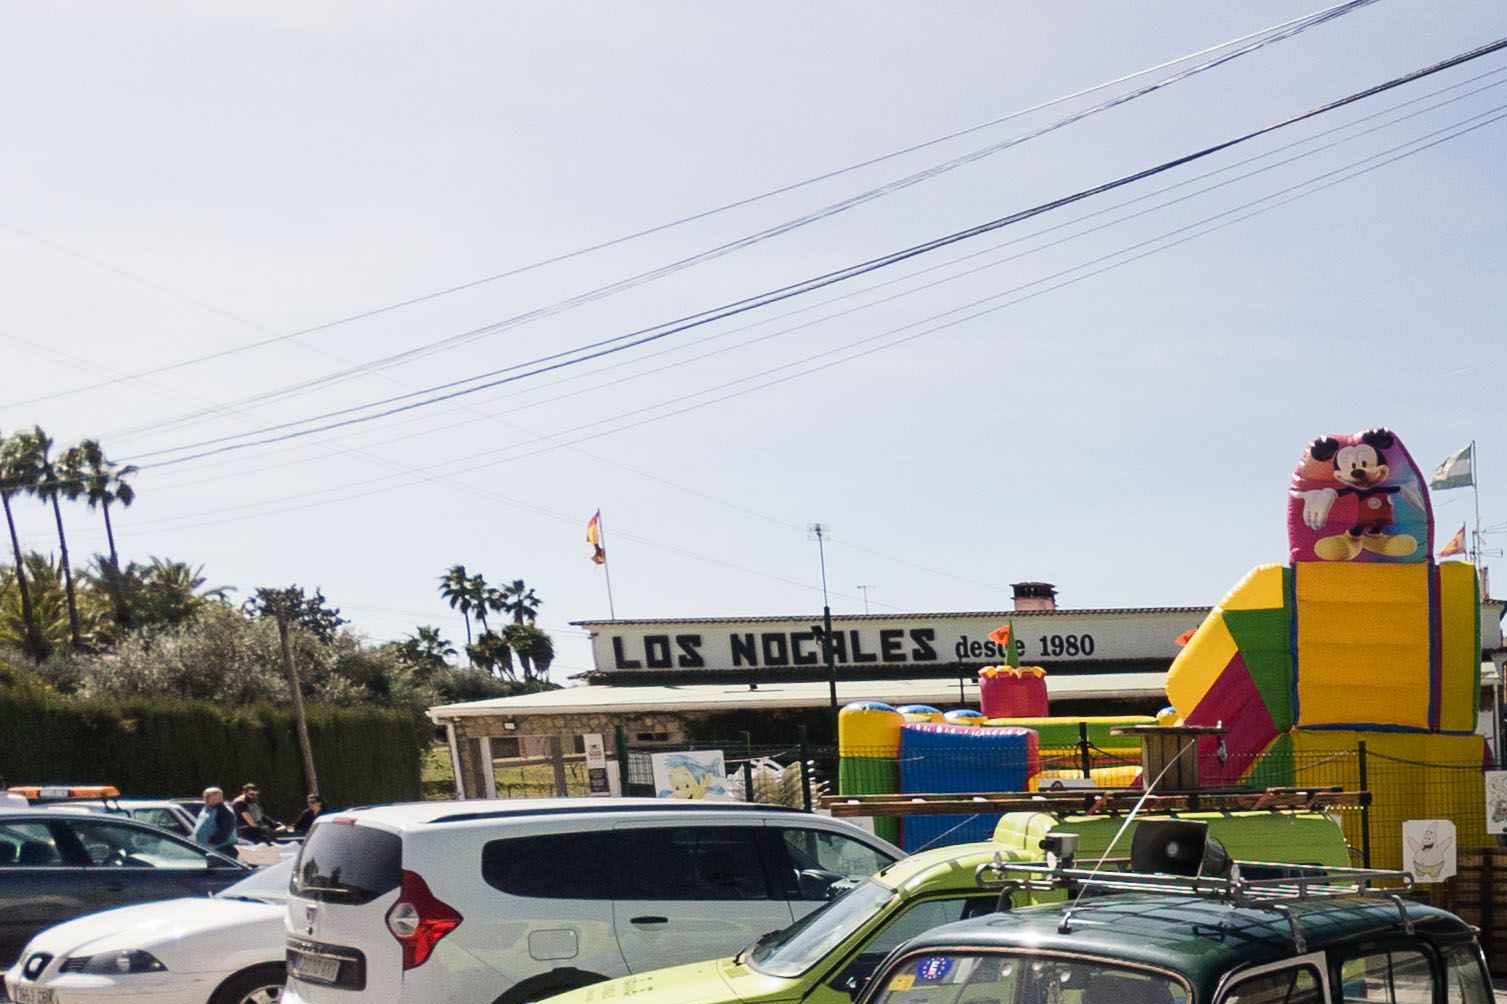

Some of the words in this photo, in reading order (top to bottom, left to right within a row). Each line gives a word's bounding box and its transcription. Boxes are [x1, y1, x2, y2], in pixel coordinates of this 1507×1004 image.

[612, 634, 704, 669] LOS
[730, 628, 937, 666] NOGALES
[1039, 634, 1095, 657] 1980
